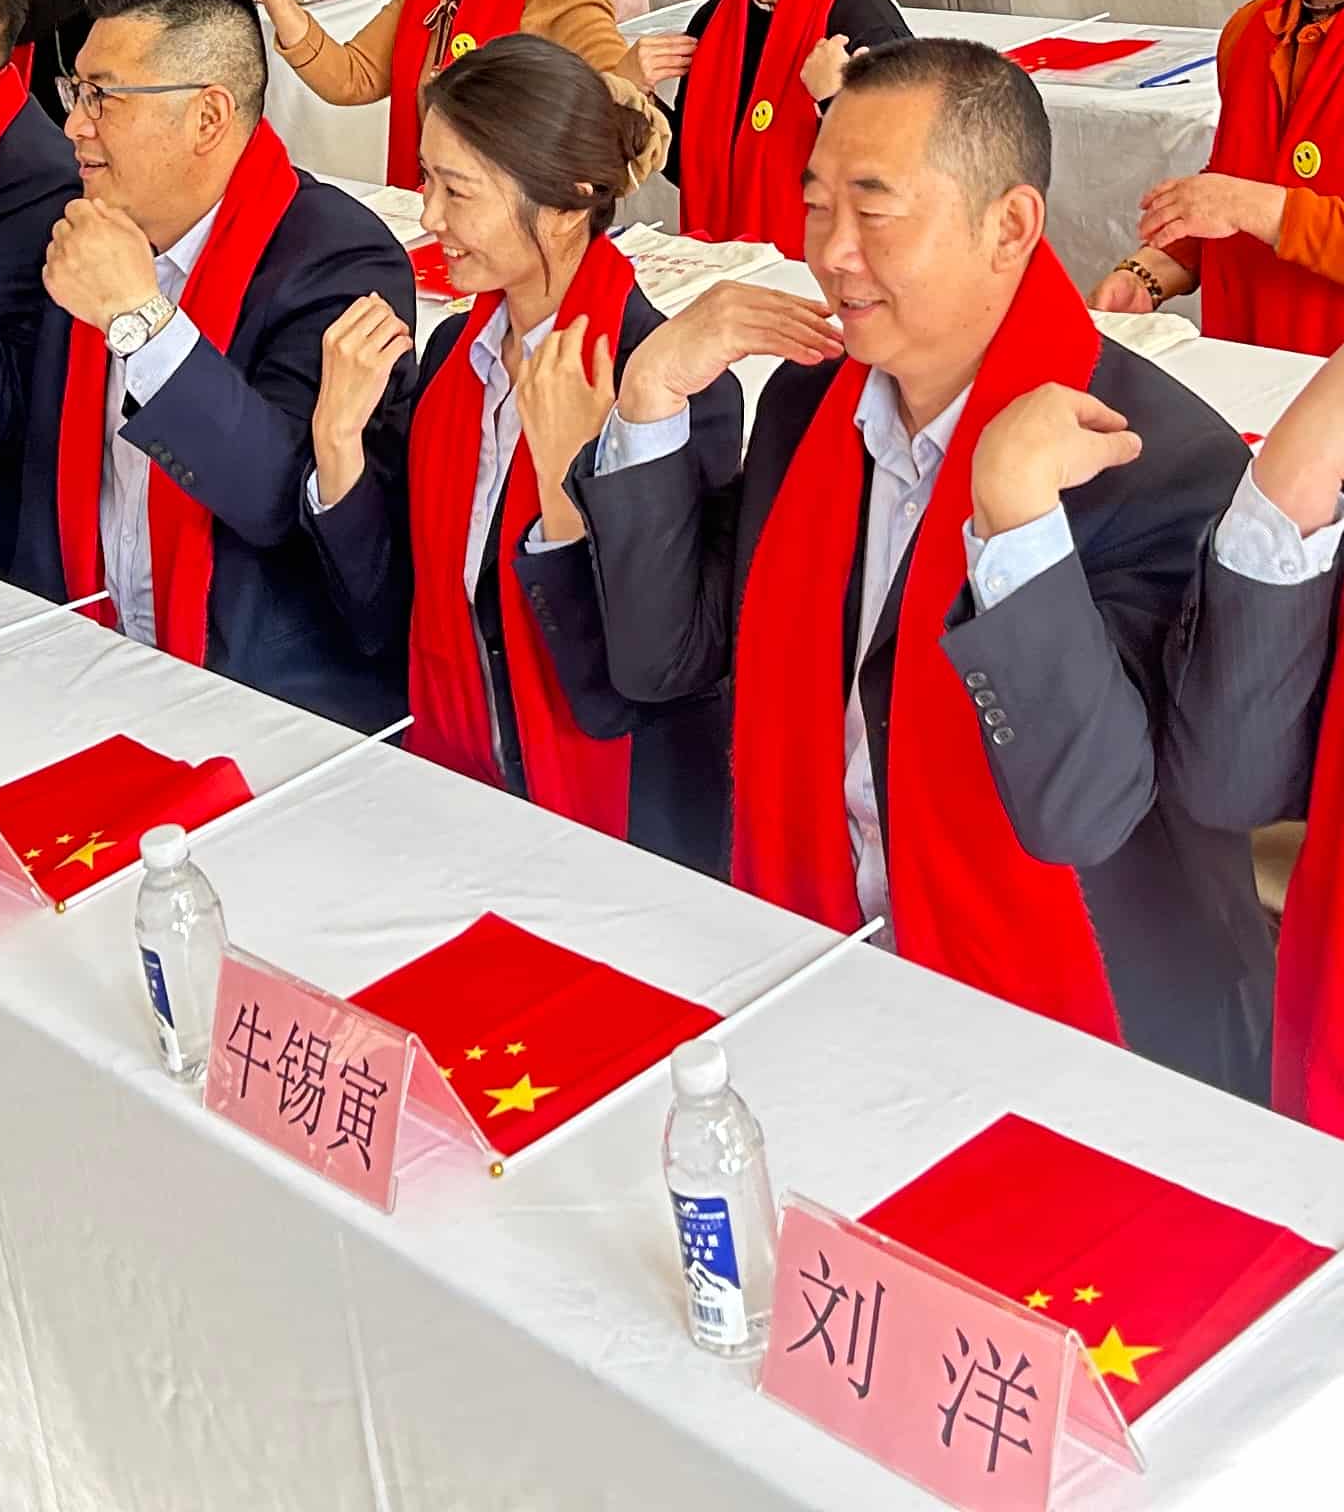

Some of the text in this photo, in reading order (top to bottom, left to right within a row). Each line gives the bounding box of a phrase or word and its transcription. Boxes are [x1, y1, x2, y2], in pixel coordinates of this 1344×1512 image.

[223, 1003, 391, 1173] 牛锡寅
[786, 1248, 1038, 1473] 刘洋
